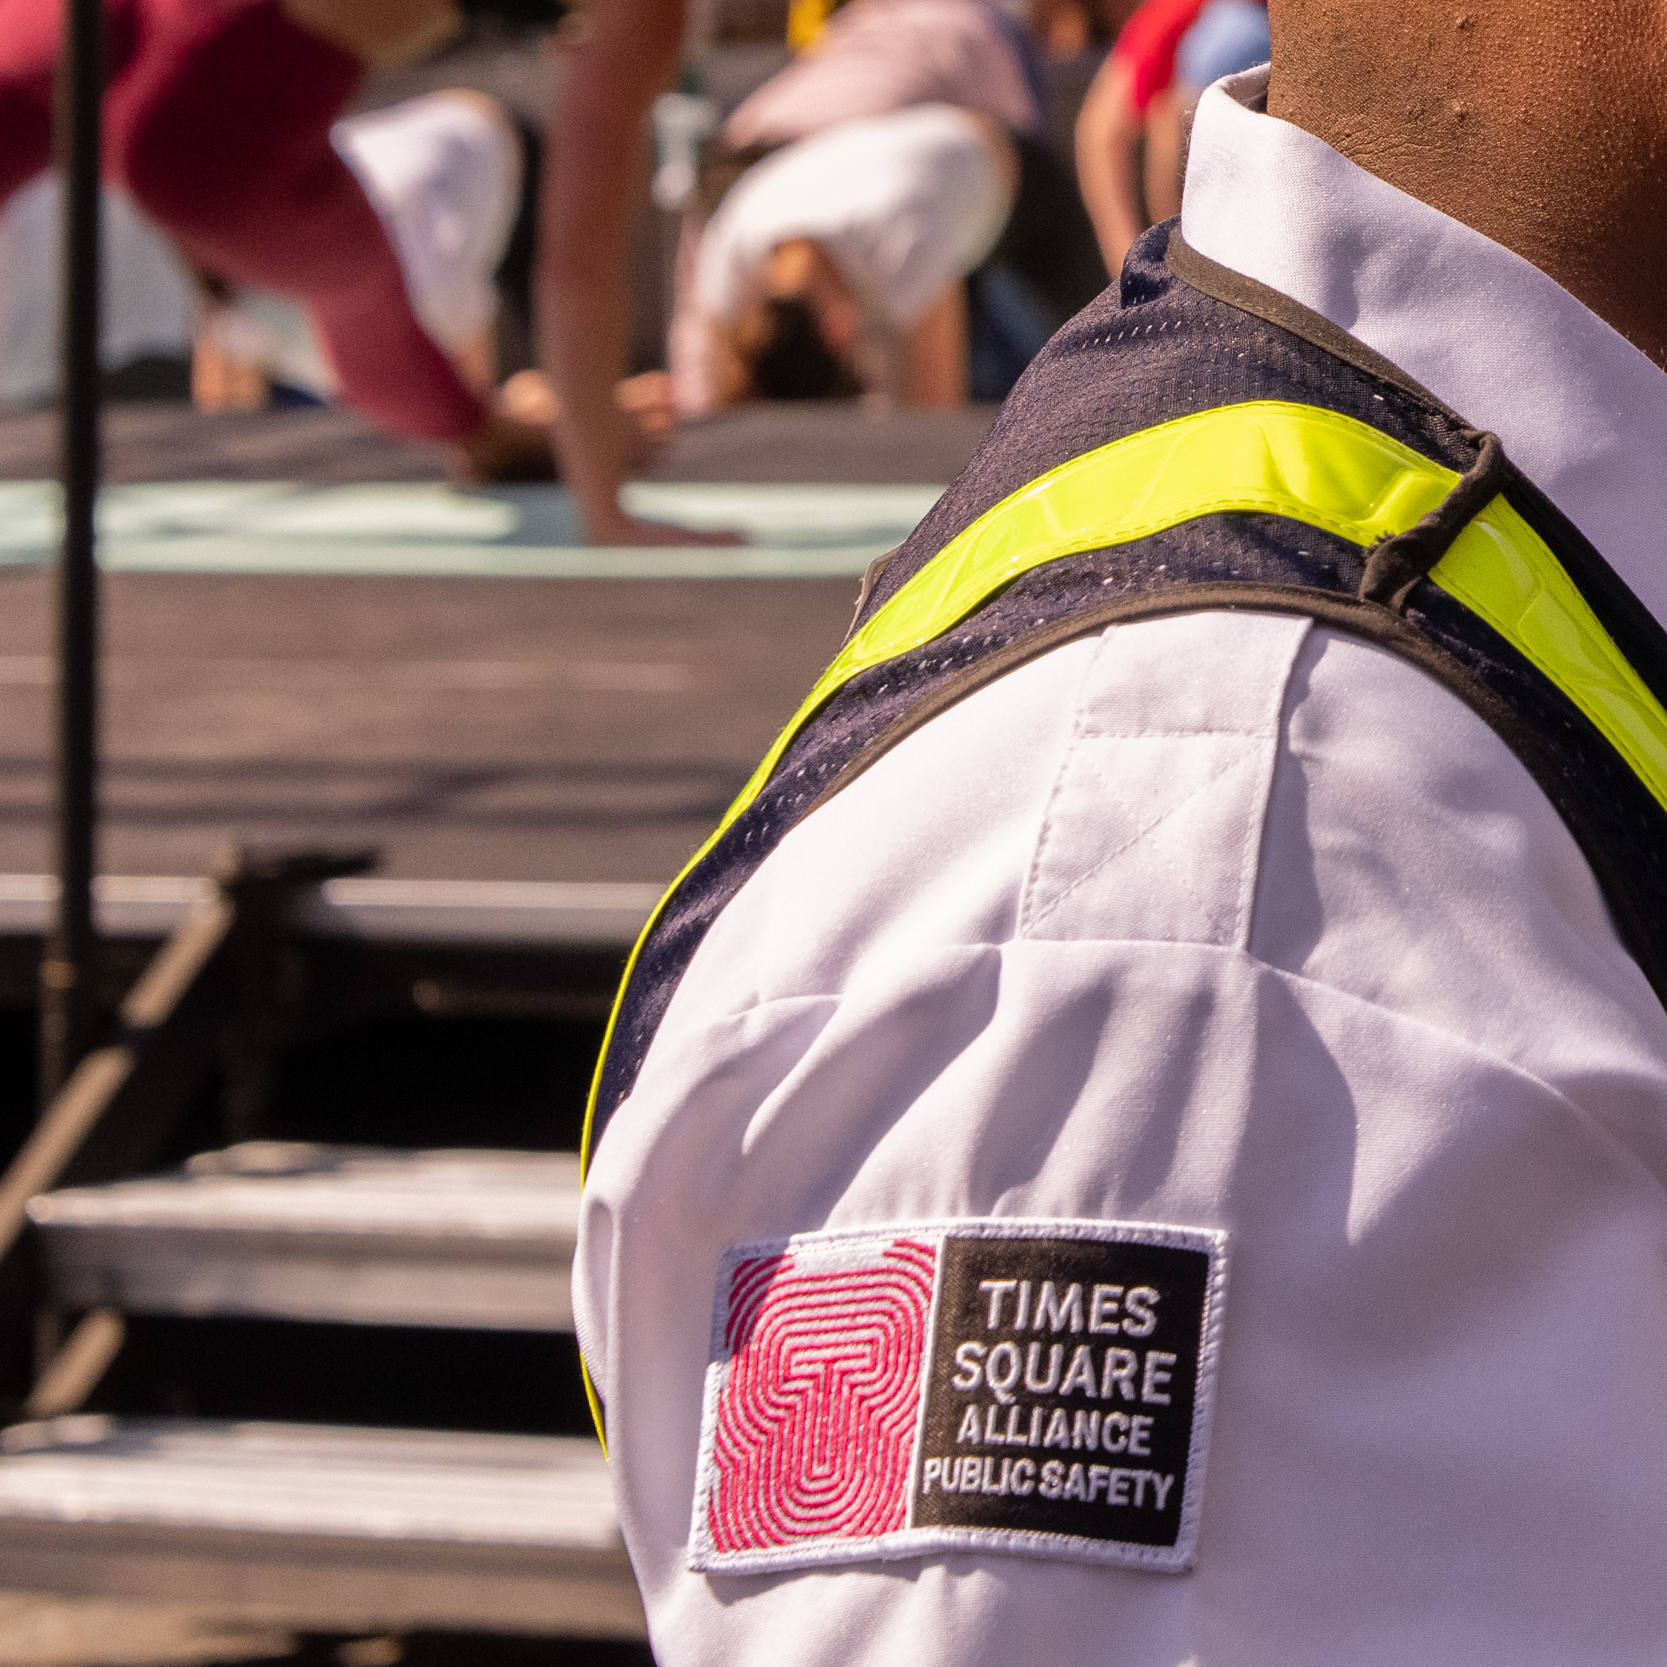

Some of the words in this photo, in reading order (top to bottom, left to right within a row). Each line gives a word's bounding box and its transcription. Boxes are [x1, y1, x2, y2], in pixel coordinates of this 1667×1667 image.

[980, 1279, 1161, 1337] TIMES
[952, 1341, 1176, 1404] SQUARE
[956, 1405, 1154, 1456] ALLIANCE
[923, 1457, 1042, 1496] PUBLIC
[1041, 1461, 1174, 1510] SAFETY
